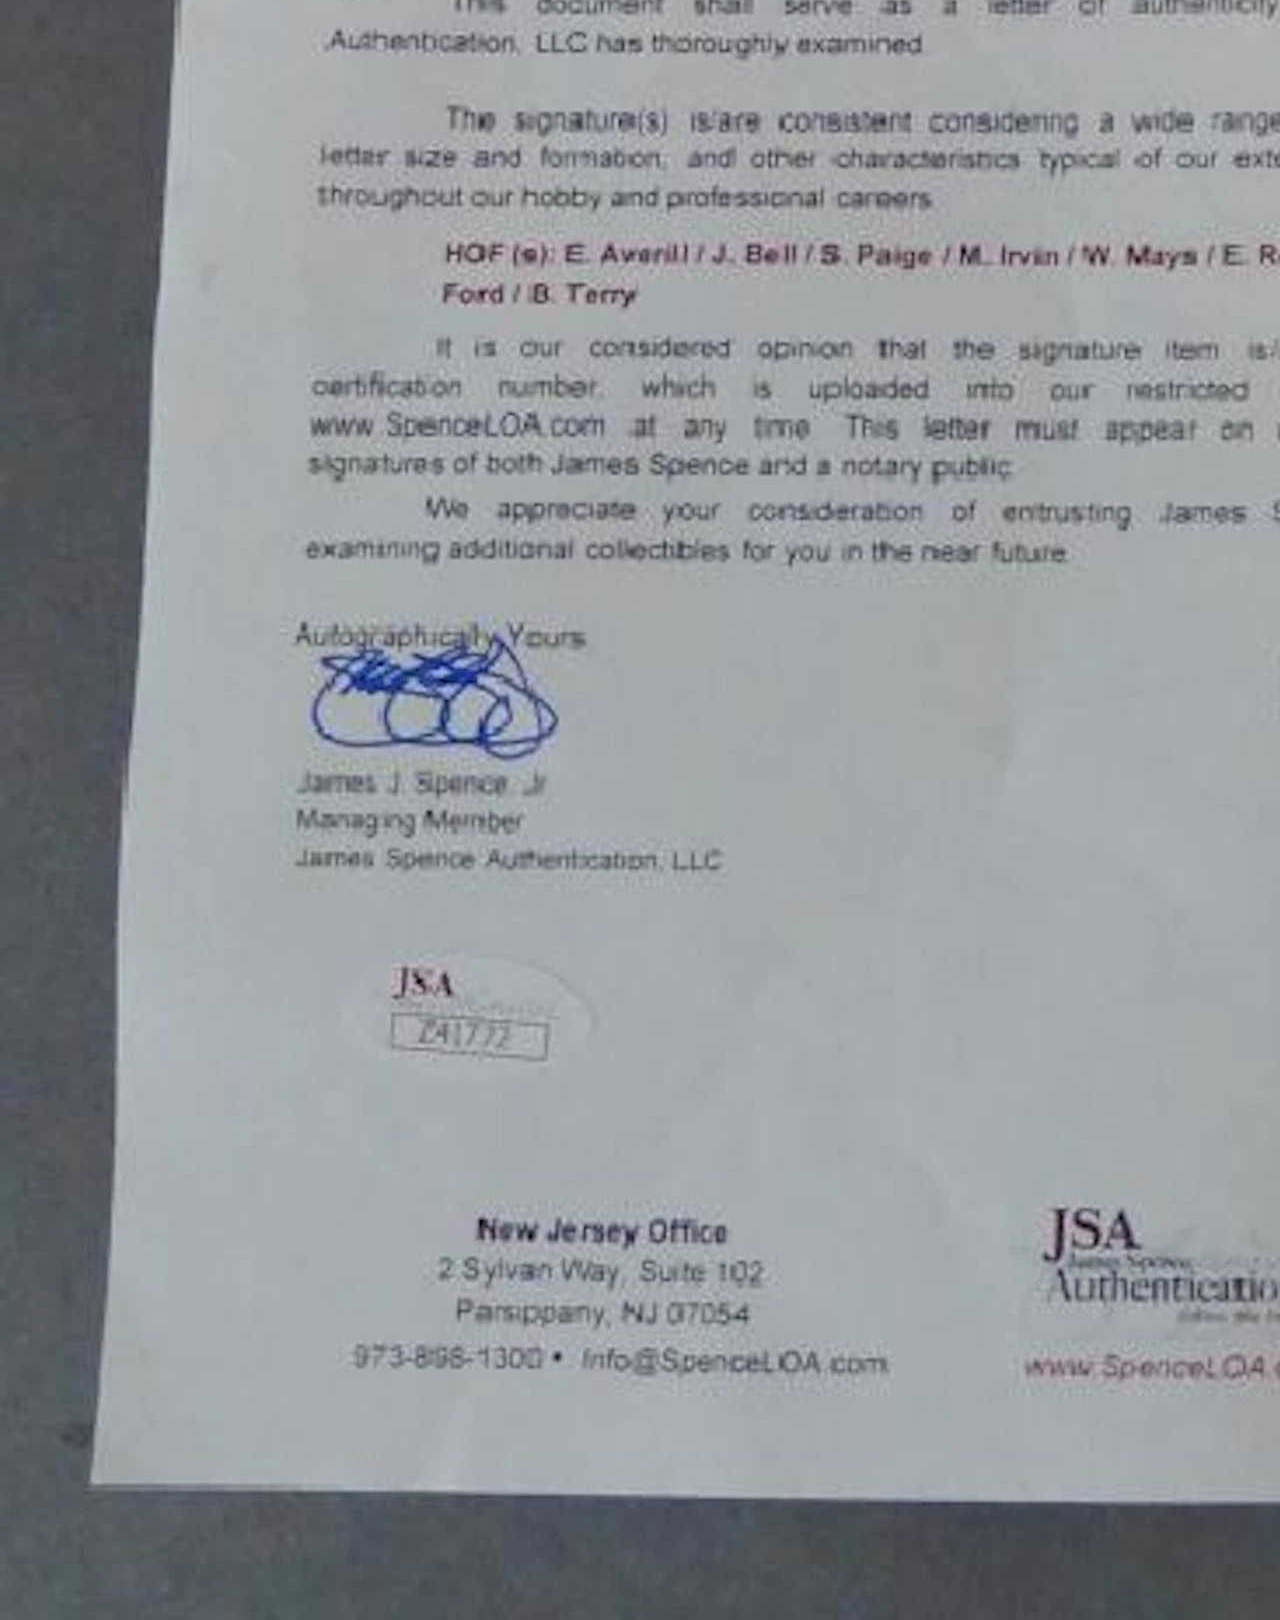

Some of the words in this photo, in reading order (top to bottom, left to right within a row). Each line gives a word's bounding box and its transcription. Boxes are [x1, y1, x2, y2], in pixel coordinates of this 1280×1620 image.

[534, 30, 589, 55] LLC
[594, 32, 645, 55] has
[650, 31, 791, 61] thoroughly
[795, 31, 923, 56] examined
[316, 183, 465, 214] throughout
[468, 188, 516, 210] our
[519, 184, 603, 214] hobby
[609, 185, 663, 209] and
[665, 184, 826, 214] professional
[307, 452, 446, 482] signatures
[451, 450, 480, 476] of
[484, 451, 546, 476] both
[549, 452, 641, 477] James
[648, 451, 751, 483] Spence
[757, 453, 809, 477] and
[814, 457, 832, 478] a
[840, 455, 923, 483] notary
[304, 540, 442, 566] examining
[447, 537, 575, 561] additional
[584, 537, 731, 564] collectibles
[741, 538, 777, 564] for
[784, 542, 832, 568] you
[840, 543, 864, 563] in
[870, 539, 914, 564] the
[920, 543, 982, 565] near
[294, 845, 375, 870] James
[384, 846, 477, 873] Spence
[670, 847, 723, 873] LLC
[394, 967, 456, 1001] JSA
[416, 1021, 514, 1051] Z41772
[475, 1215, 541, 1244] New
[545, 1217, 641, 1251] Jersey
[648, 1217, 728, 1246] Office
[1043, 1207, 1142, 1262] JSA
[437, 1255, 456, 1282] 2
[461, 1256, 553, 1292] Sylvan
[638, 1255, 708, 1288] Suite
[715, 1259, 766, 1291] 102
[619, 1299, 660, 1327] NJ
[665, 1300, 752, 1329] 07054
